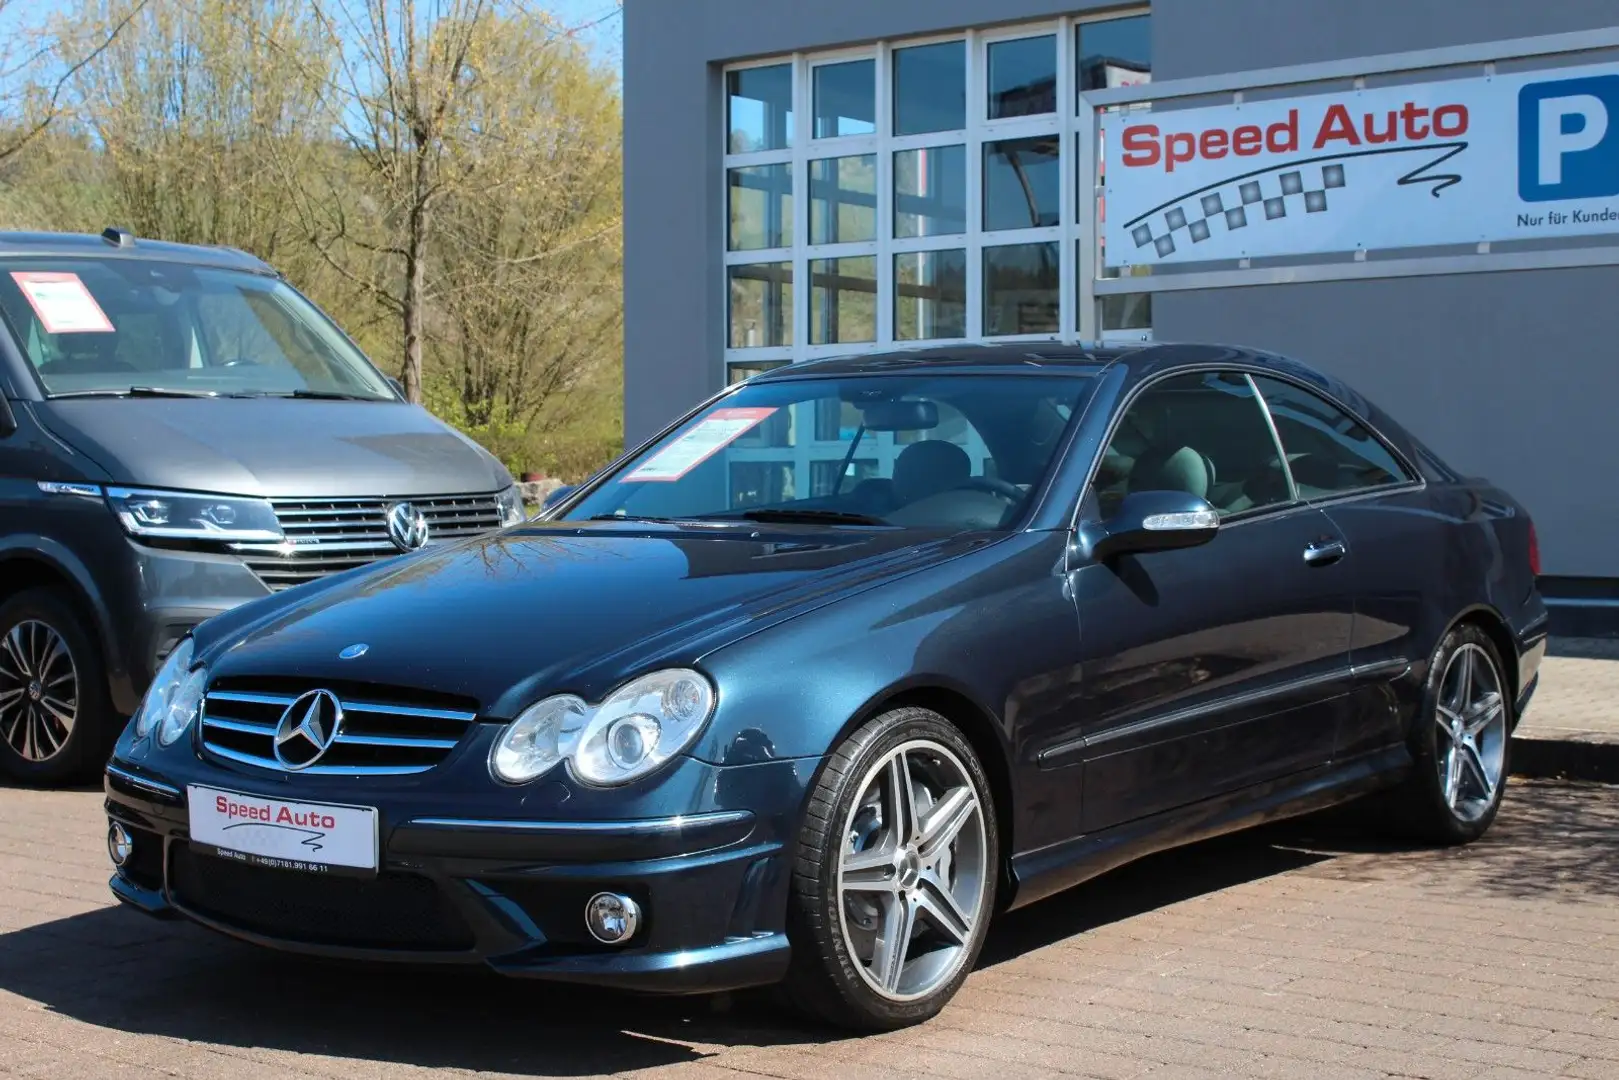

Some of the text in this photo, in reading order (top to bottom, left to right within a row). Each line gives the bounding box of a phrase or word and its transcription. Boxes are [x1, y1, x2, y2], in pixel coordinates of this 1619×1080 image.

[1121, 102, 1469, 173] Speed Auto
[1538, 94, 1609, 185] P
[1516, 207, 1619, 227] Nur für Kunde
[216, 795, 335, 829] Speed Auto
[216, 847, 233, 859] Speed
[233, 851, 246, 861] Auto
